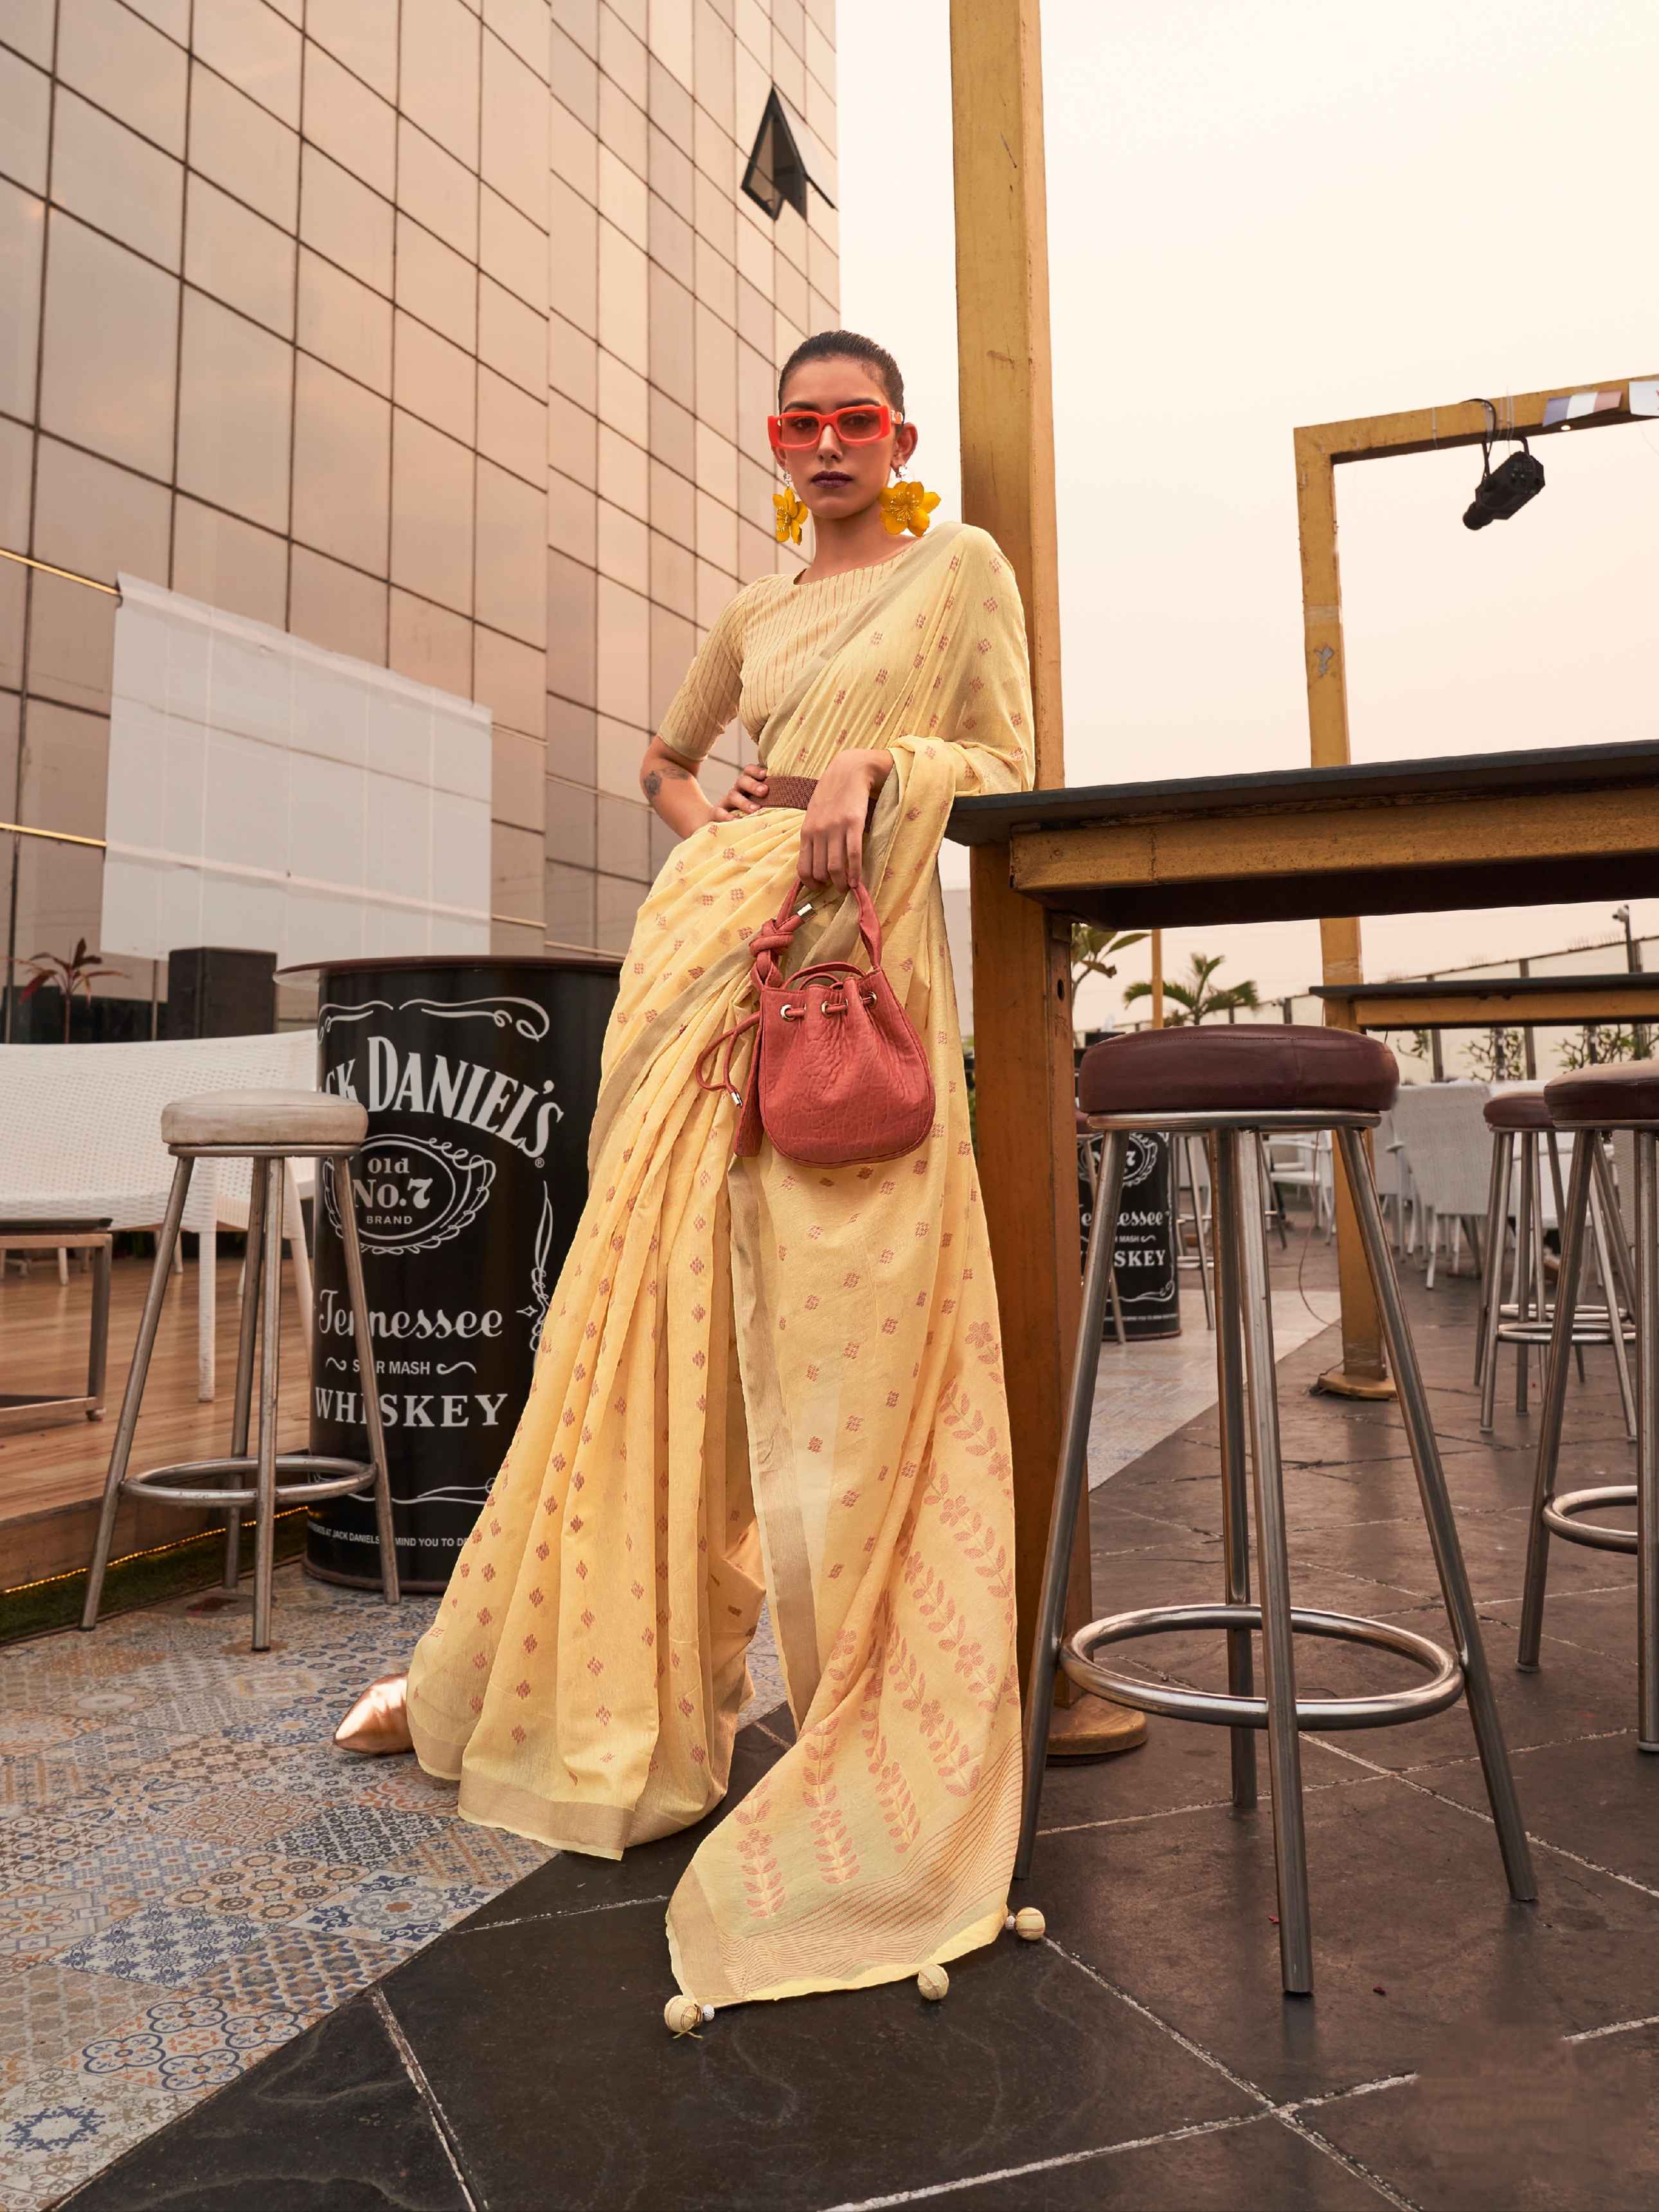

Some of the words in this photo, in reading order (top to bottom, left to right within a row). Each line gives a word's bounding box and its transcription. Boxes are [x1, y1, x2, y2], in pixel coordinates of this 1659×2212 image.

[319, 1059, 358, 1103] CK
[367, 1036, 564, 1157] DANIEL'S
[367, 1158, 410, 1174] old
[366, 1215, 413, 1224] BRAND
[353, 1359, 385, 1373] SR
[389, 1361, 430, 1375] MASH
[349, 1533, 379, 1544] DANIELS
[418, 1538, 438, 1546] YOU
[441, 1538, 454, 1546] TO
